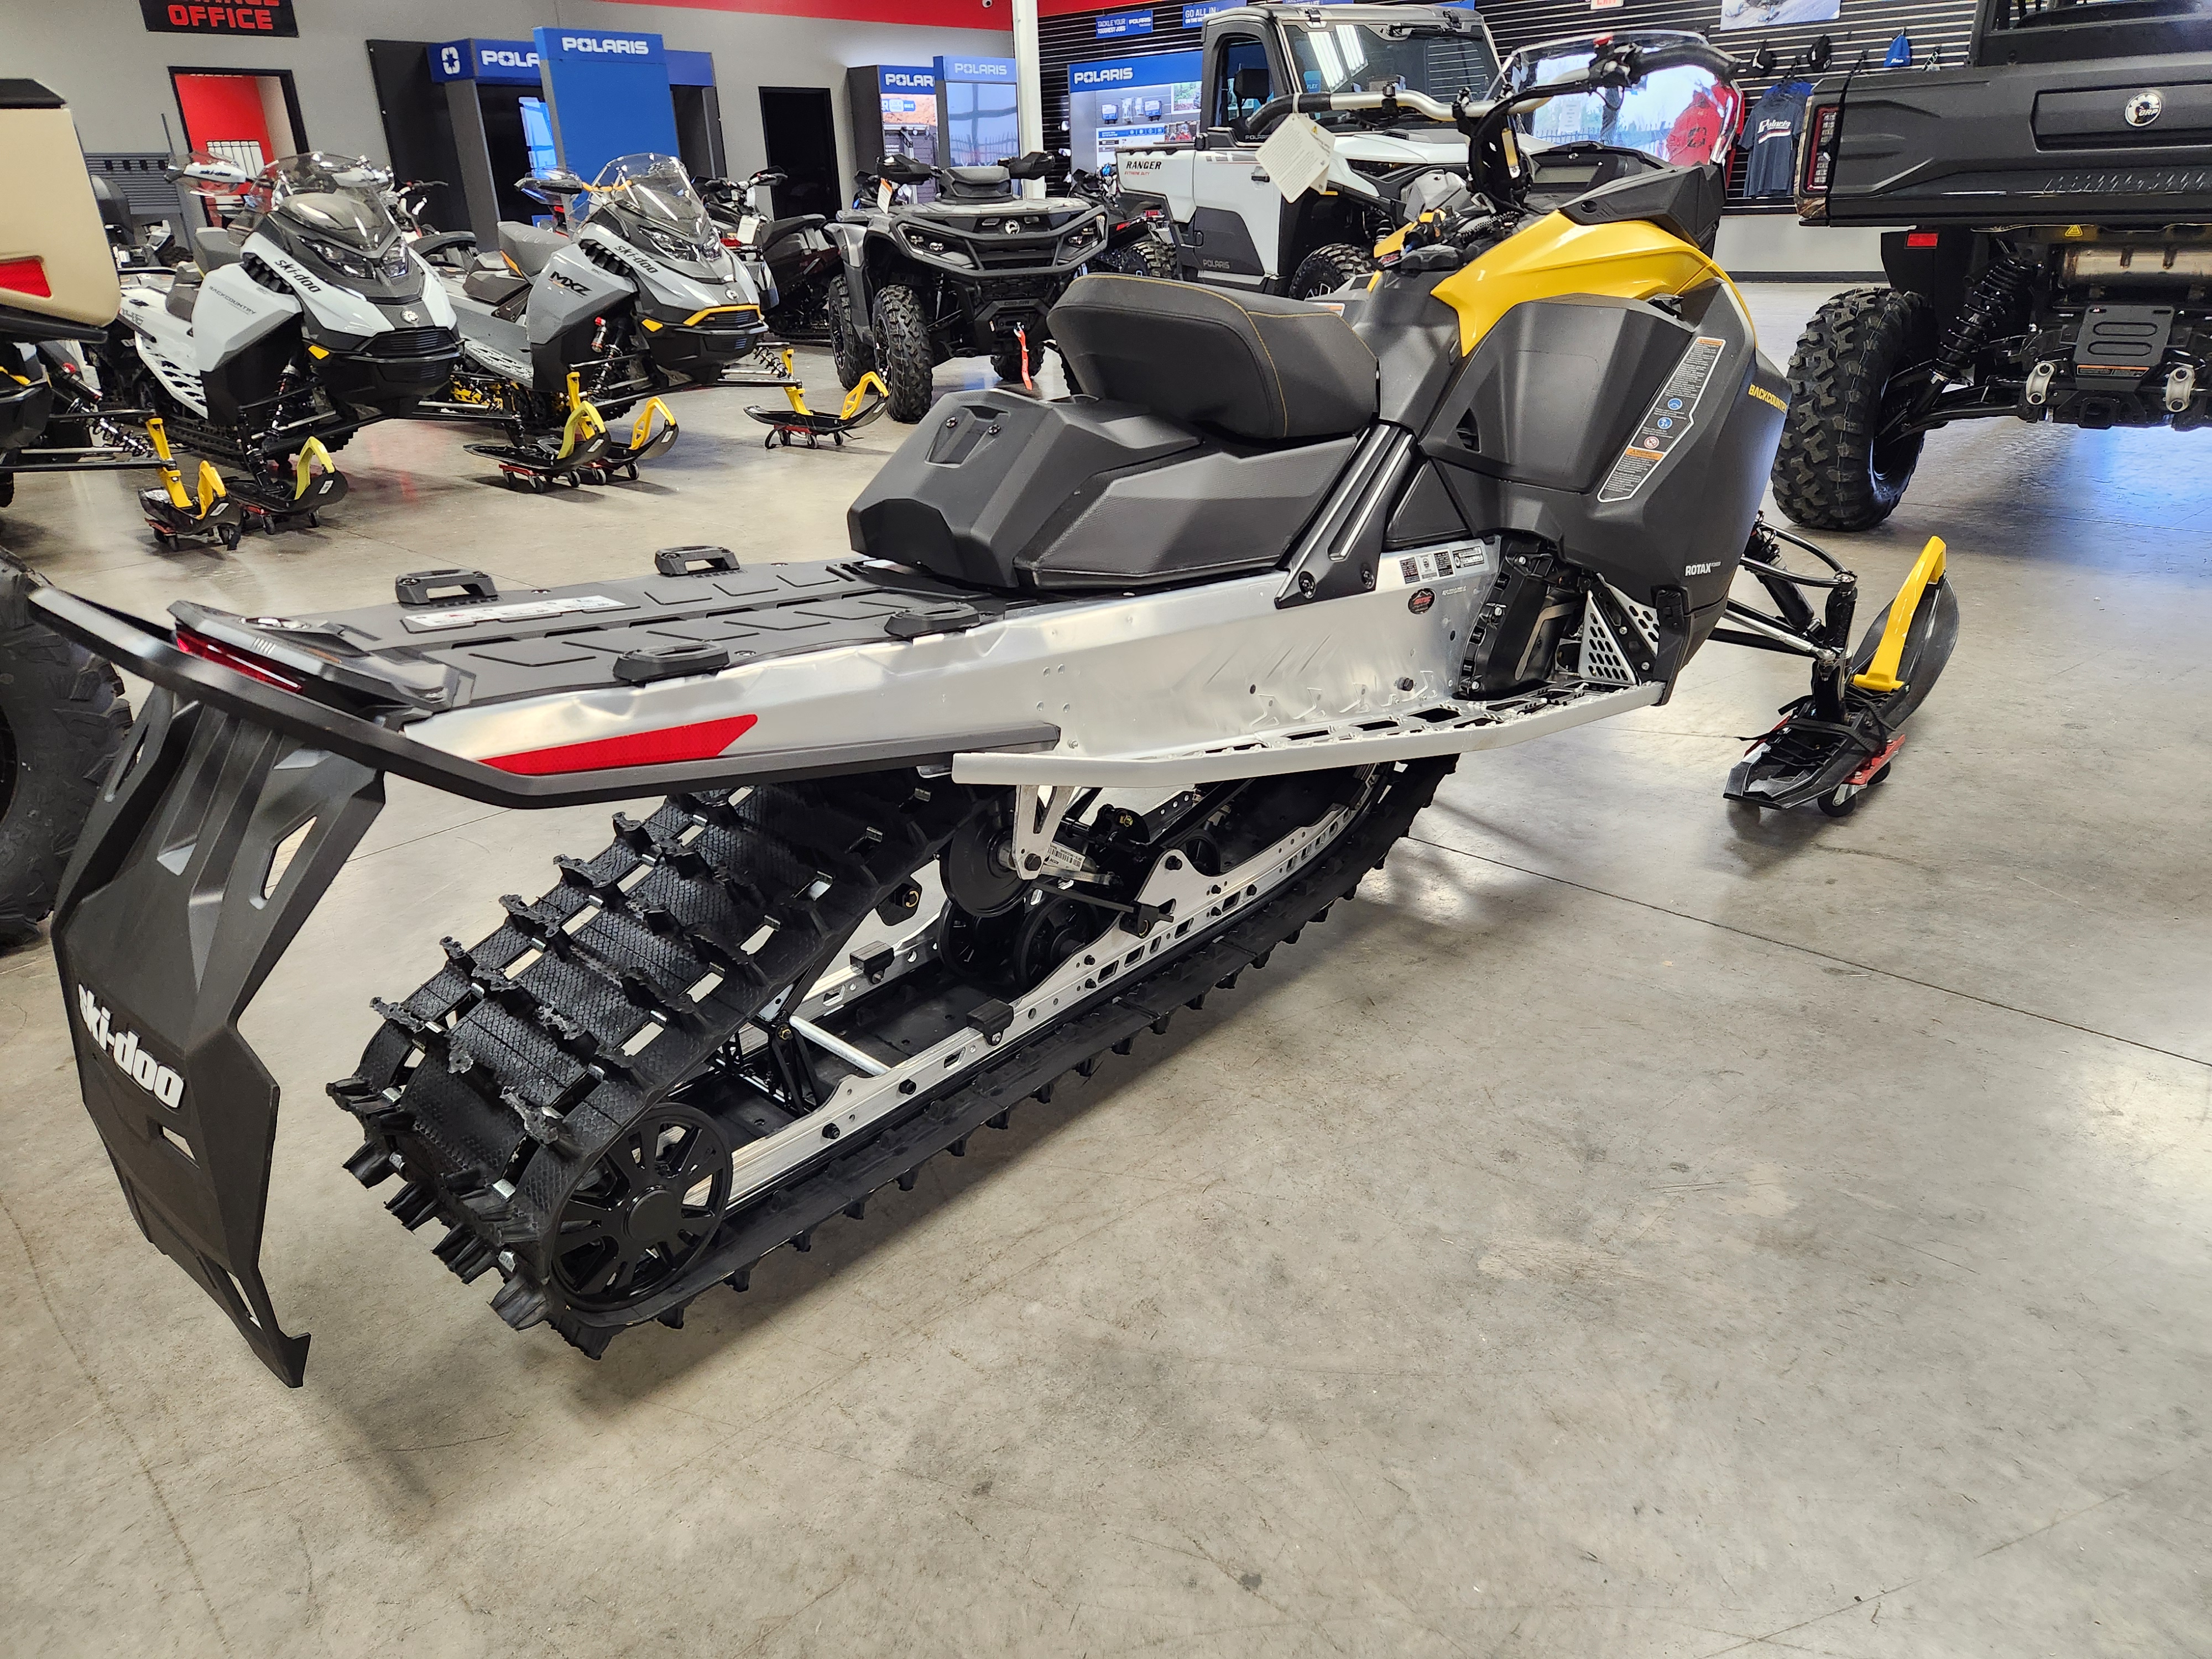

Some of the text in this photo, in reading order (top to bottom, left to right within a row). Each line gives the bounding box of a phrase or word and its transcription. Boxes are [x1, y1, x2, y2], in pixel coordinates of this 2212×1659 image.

[168, 5, 273, 29] OFFICE
[1185, 9, 1194, 18] GO
[1196, 8, 1206, 17] ALL
[1097, 18, 1126, 28] TACKLE YOUR
[562, 37, 649, 55] POLARIS
[481, 50, 541, 67] POLA
[954, 63, 1008, 76] POLARIS
[1074, 67, 1133, 85] POLARIS
[885, 73, 935, 87] POLAR
[1757, 118, 1792, 133] Polaris
[1126, 161, 1162, 170] RANGER
[614, 246, 659, 273] ski-doo
[1202, 258, 1230, 269] POLARIS
[274, 259, 322, 293] ski-doo
[550, 270, 593, 296] MXZ
[208, 285, 257, 315] BACKCOUNTRY
[1684, 562, 1712, 576] ROTAX
[78, 983, 184, 1108] ski-doo
